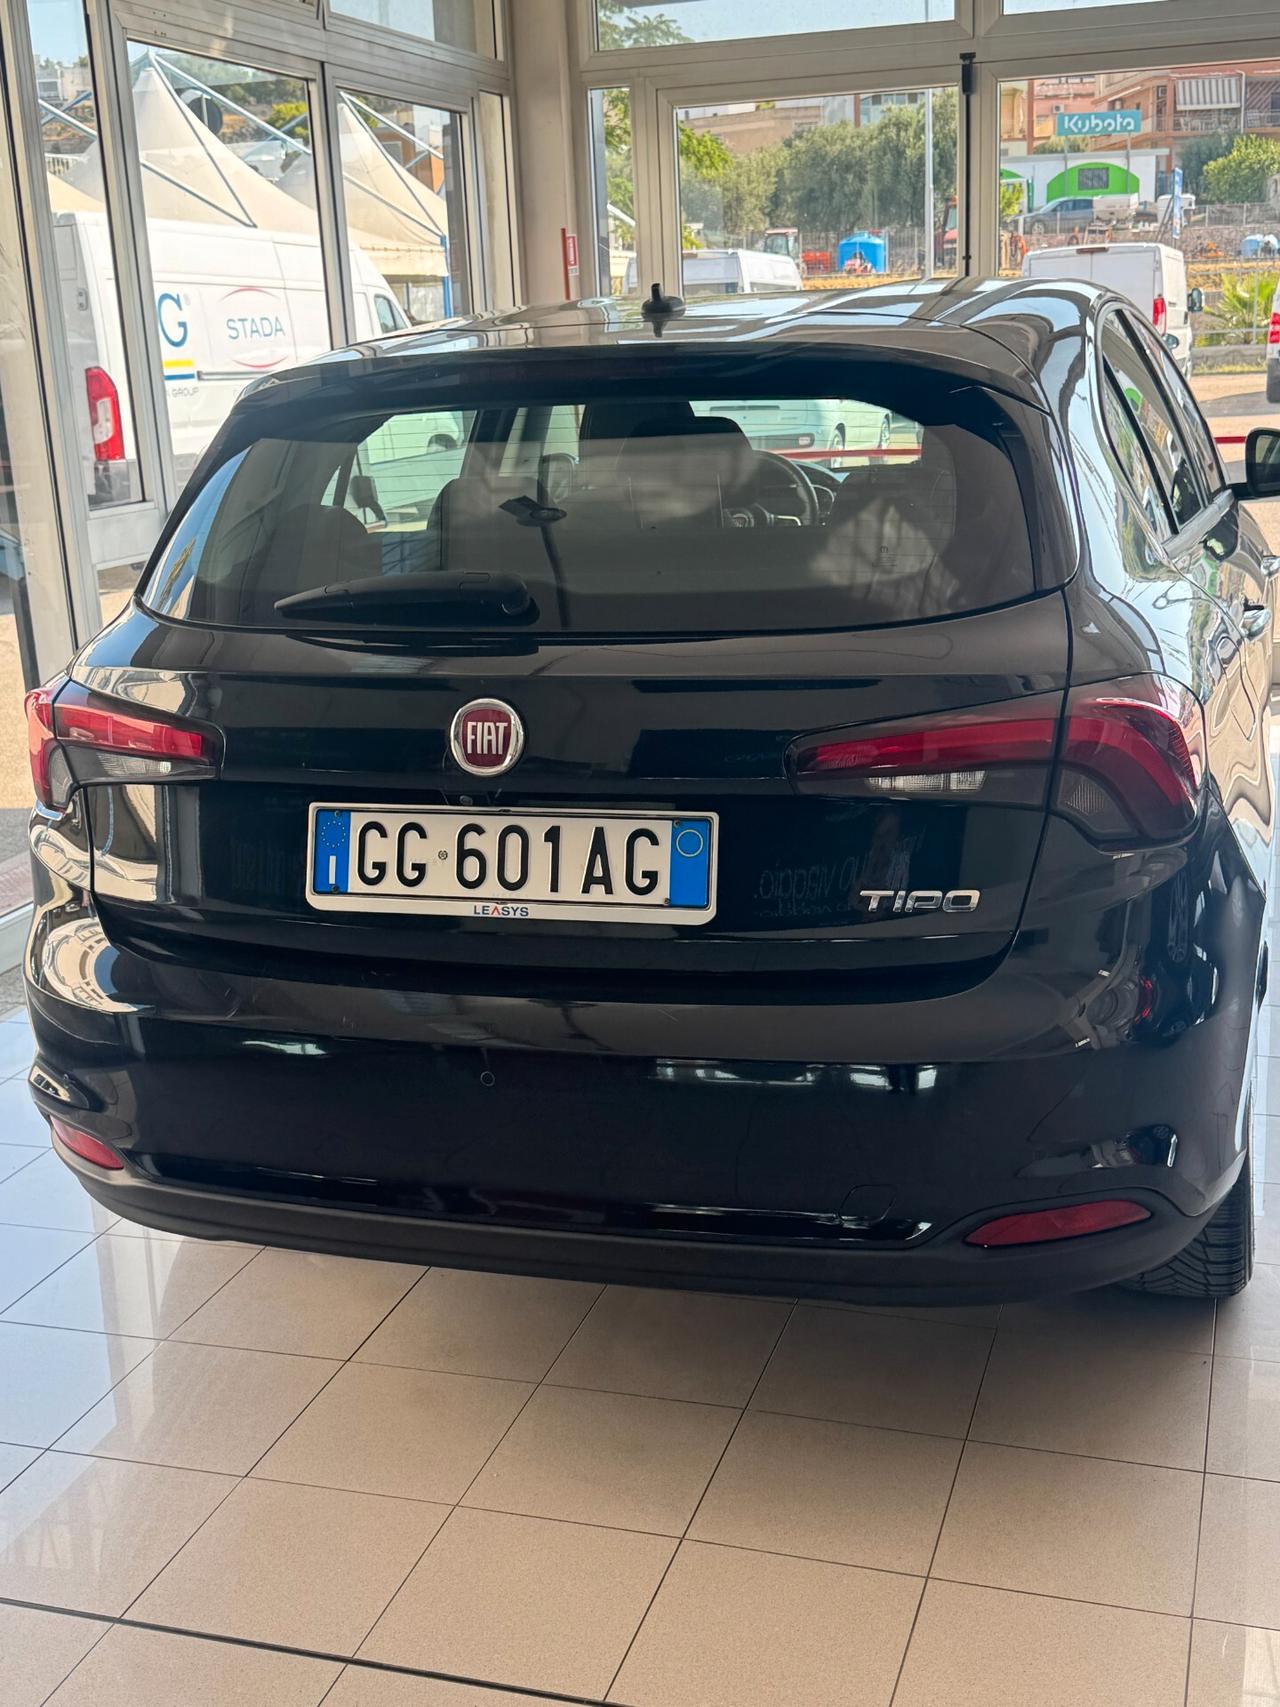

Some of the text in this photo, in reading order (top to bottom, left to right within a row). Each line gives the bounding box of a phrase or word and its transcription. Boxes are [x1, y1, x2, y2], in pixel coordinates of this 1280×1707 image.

[1064, 113, 1135, 133] Kubota
[226, 315, 285, 340] STADA
[467, 721, 508, 755] FIAT
[357, 820, 428, 888] GG
[473, 904, 529, 918] LEASYS
[859, 889, 981, 913] TIPO
